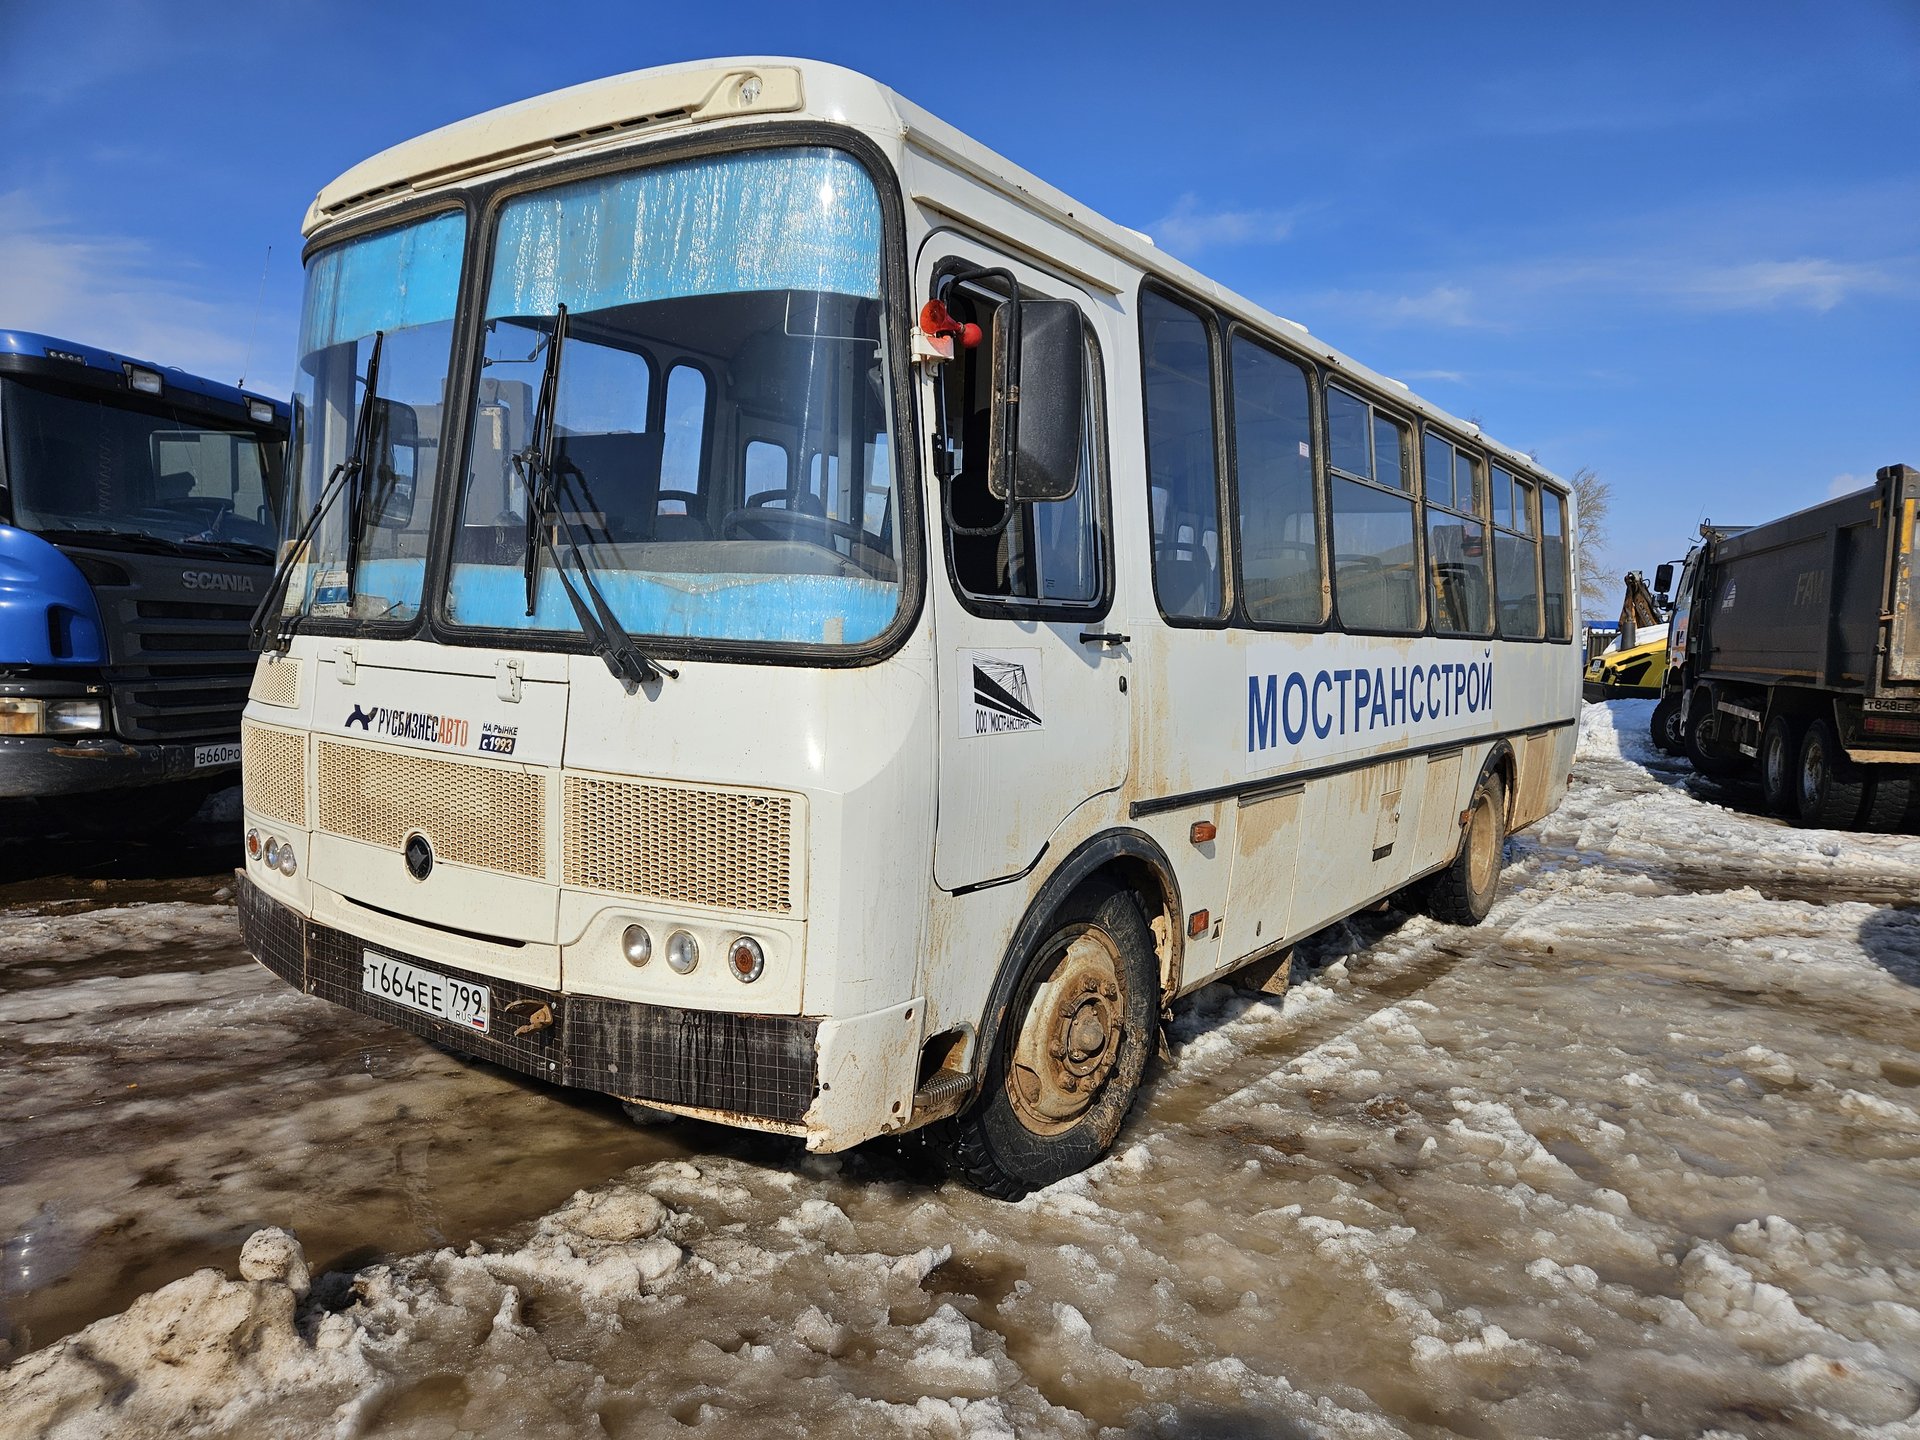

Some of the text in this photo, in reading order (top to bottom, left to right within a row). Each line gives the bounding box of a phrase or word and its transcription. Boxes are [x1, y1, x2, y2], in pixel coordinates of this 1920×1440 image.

[182, 570, 254, 593] SCANIA
[1248, 648, 1493, 753] МОСТРАНССТРОЙ
[377, 707, 470, 748] РУСБИЗНЕСАВТО
[482, 722, 519, 736] НА РЫНКЕ
[449, 982, 483, 1016] 799
[455, 1009, 472, 1023] RUS
